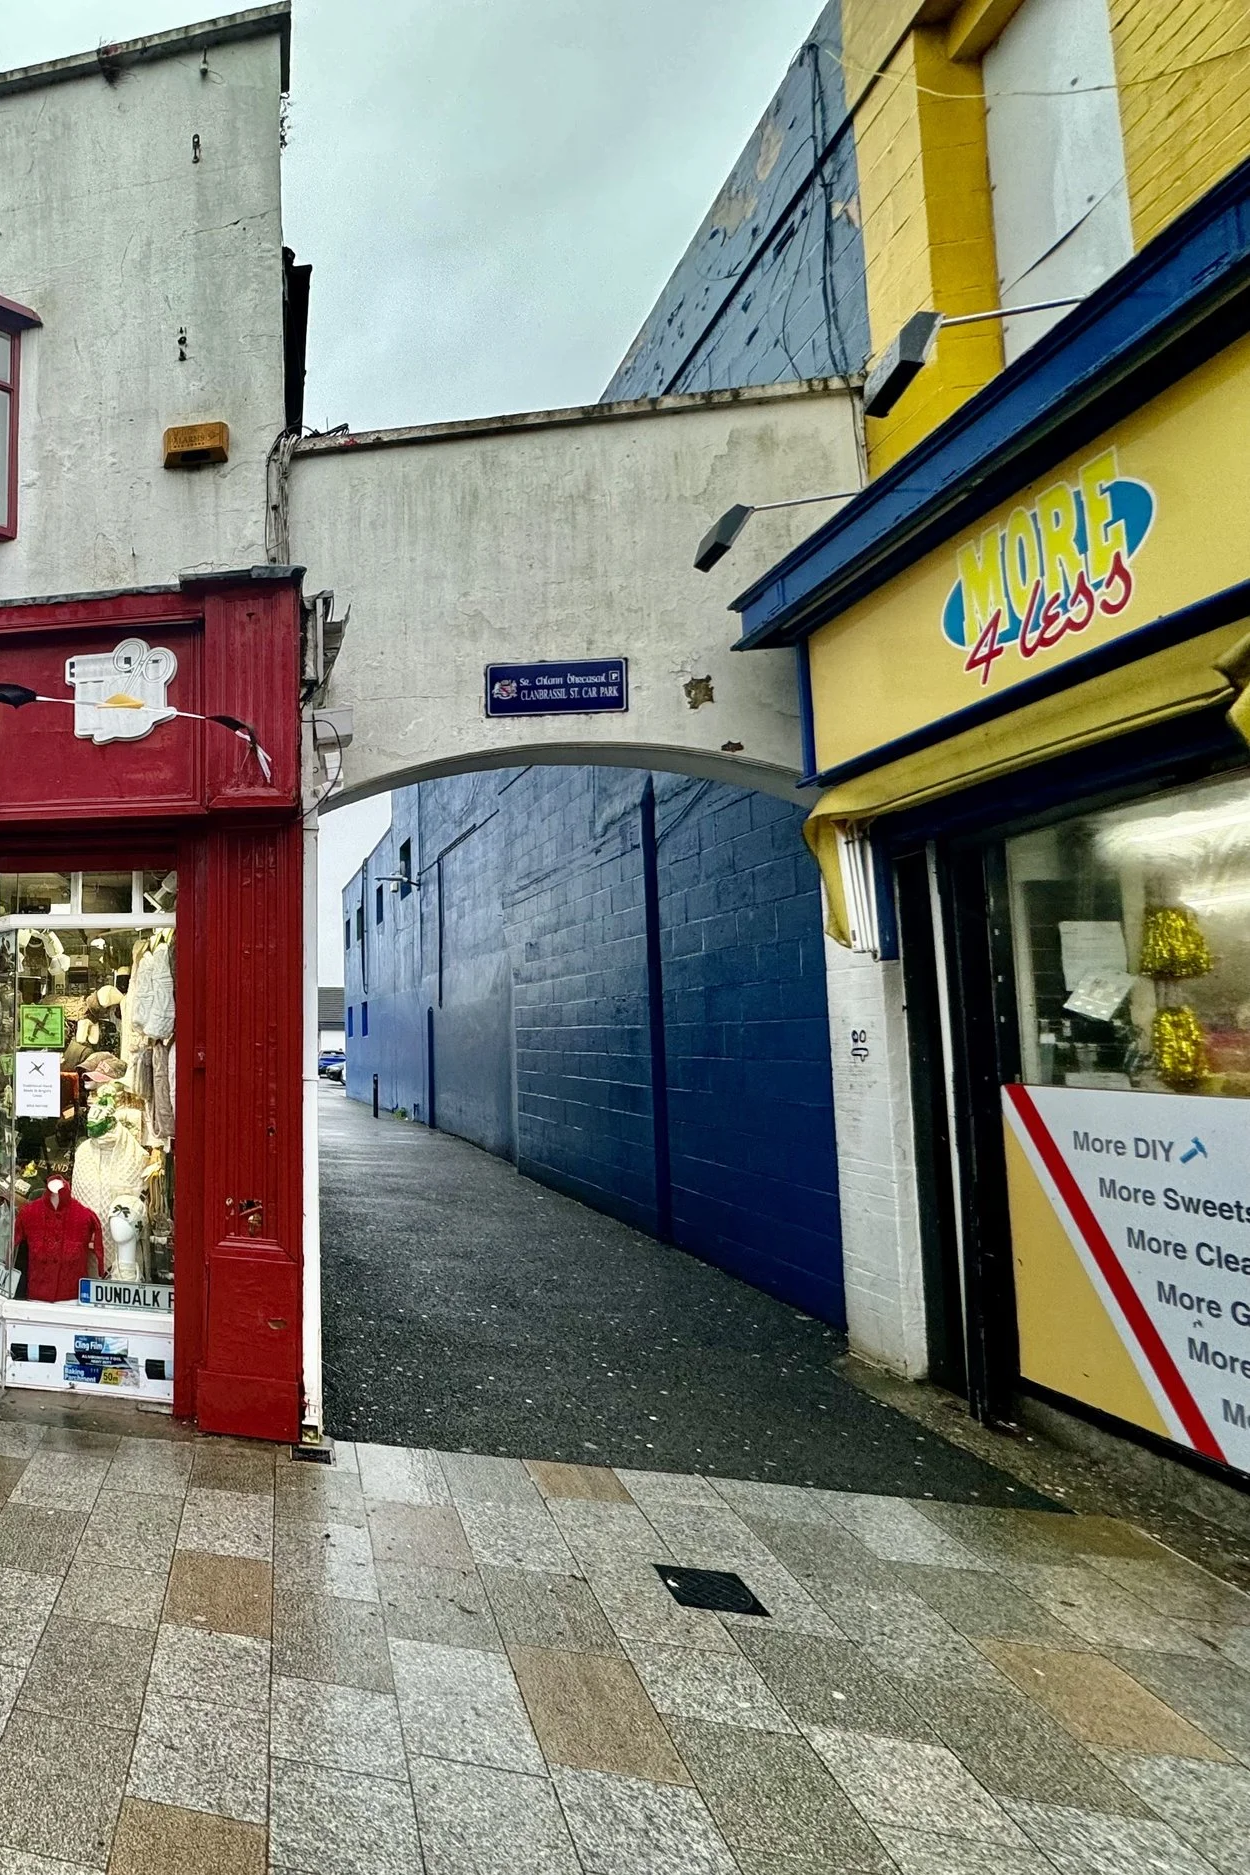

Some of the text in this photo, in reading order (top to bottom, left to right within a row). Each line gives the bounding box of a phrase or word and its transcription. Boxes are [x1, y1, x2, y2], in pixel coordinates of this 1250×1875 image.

[956, 446, 1128, 648] MORE
[964, 608, 1005, 686] 4
[520, 685, 619, 701] CLANBRASSIL ST. CAR PARK
[1072, 1130, 1175, 1162] More DIY
[1099, 1177, 1157, 1207] More
[1126, 1227, 1188, 1260] More
[95, 1285, 161, 1308] DUNDALK
[1156, 1280, 1222, 1319] More
[75, 1341, 103, 1351] Cling Film
[64, 1367, 85, 1376] Baking
[64, 1375, 97, 1383] Parchment
